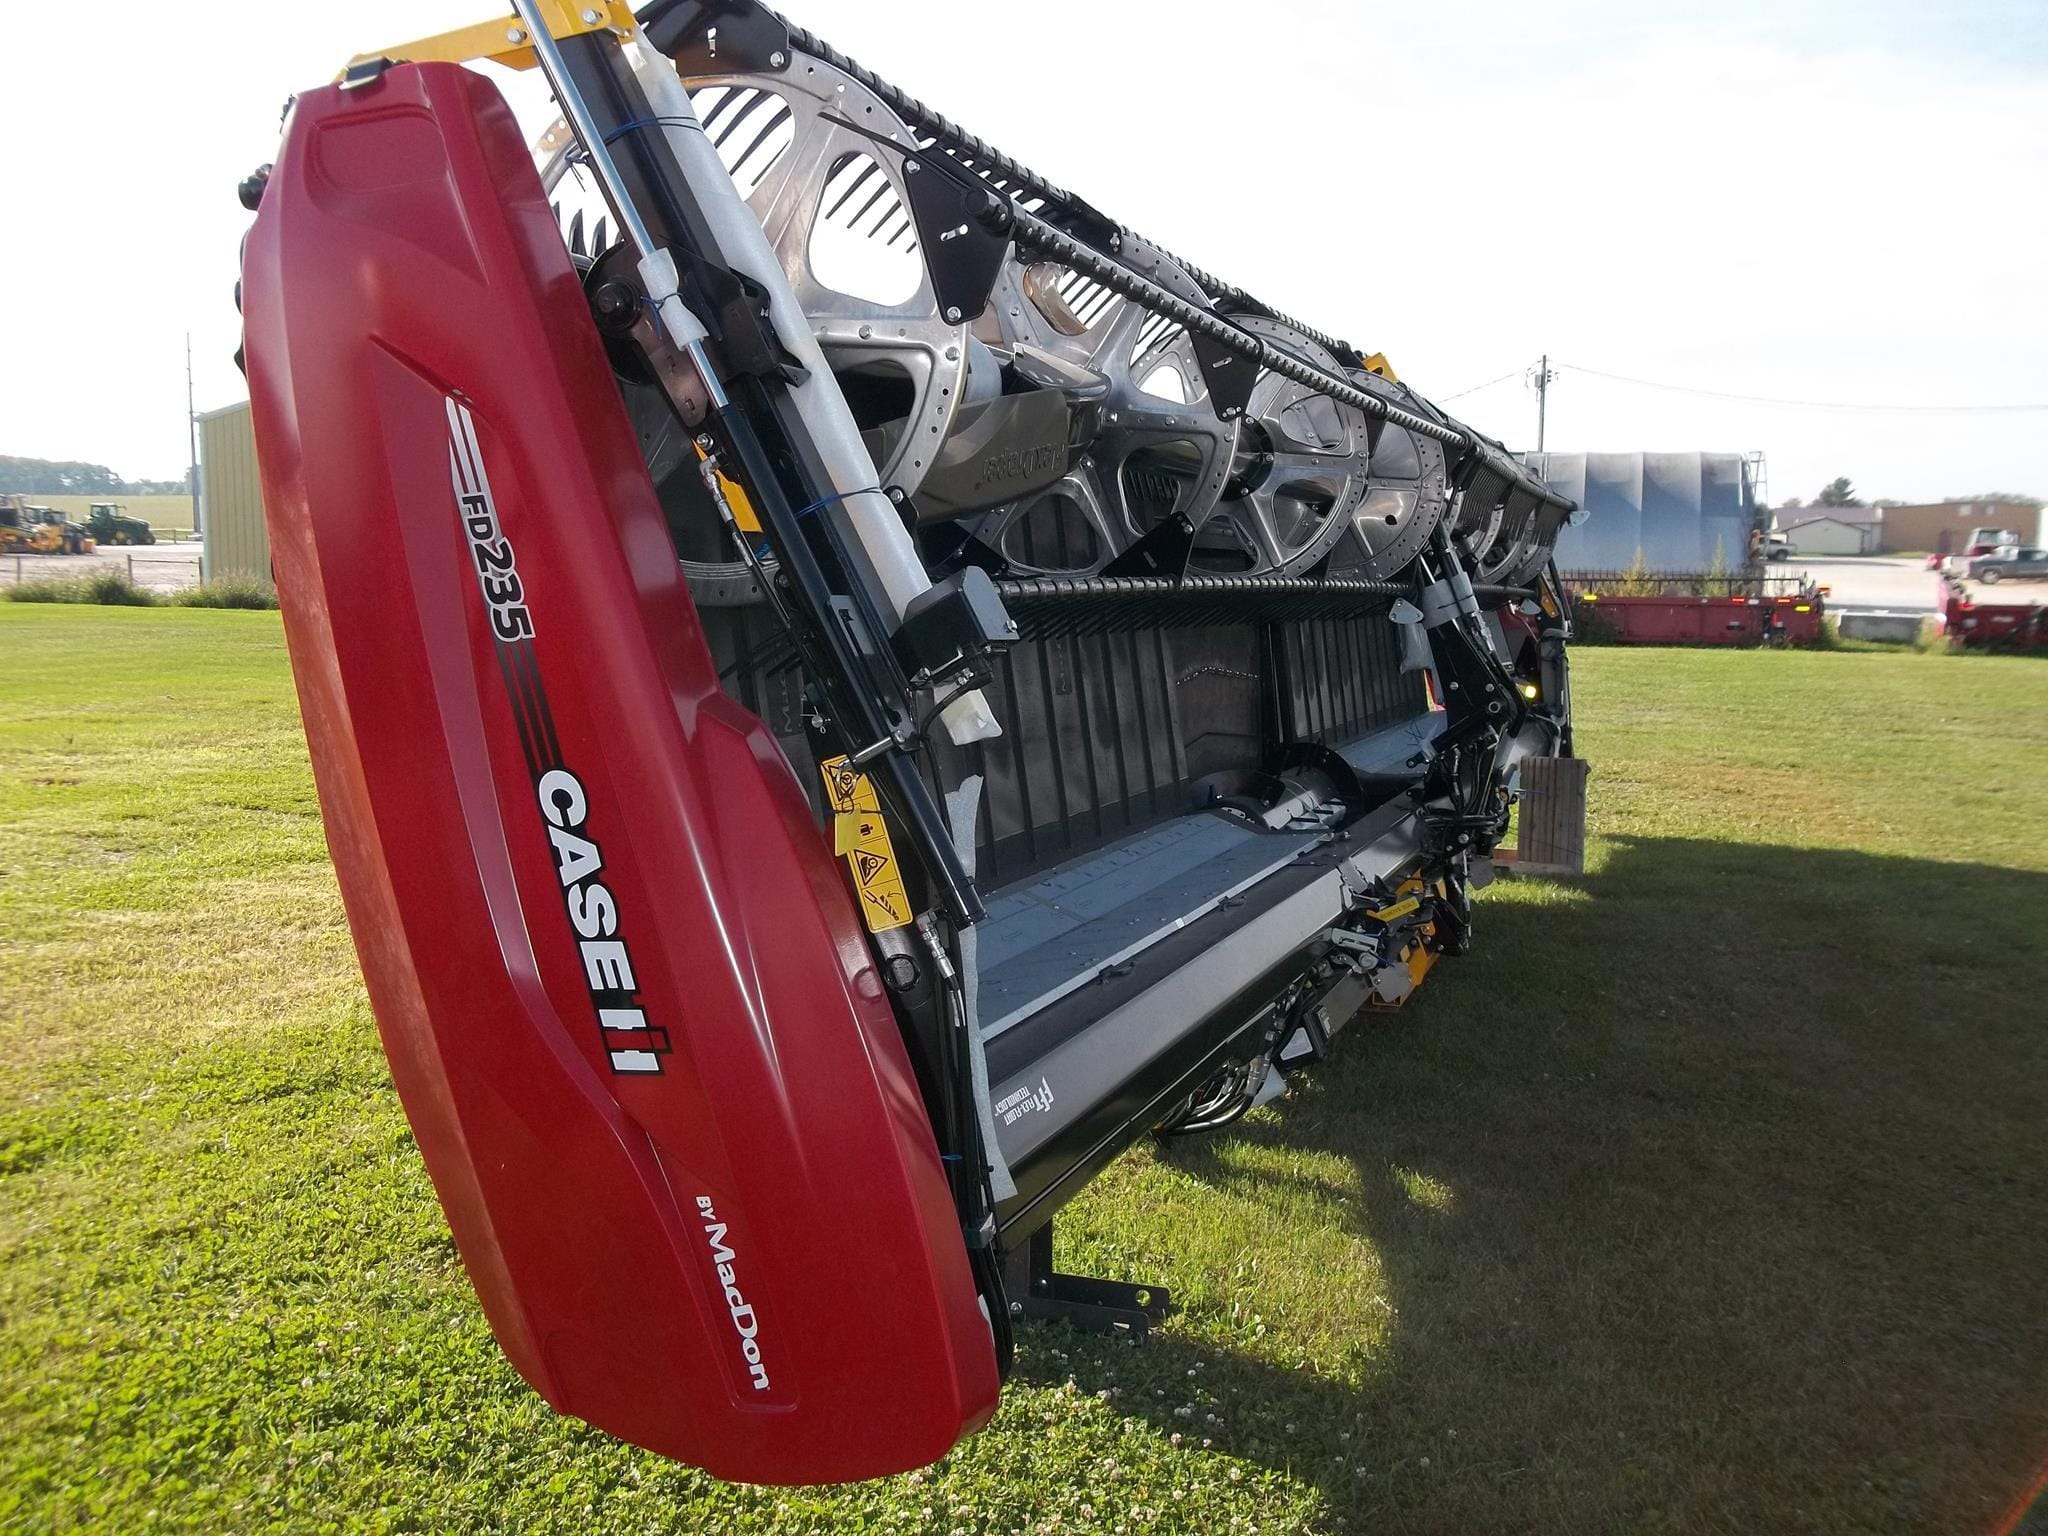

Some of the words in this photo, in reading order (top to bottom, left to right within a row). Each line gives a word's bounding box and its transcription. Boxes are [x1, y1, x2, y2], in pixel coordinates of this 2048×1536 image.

[461, 495, 536, 642] FD235
[538, 769, 636, 991] CASE
[996, 1086, 1031, 1114] TECHNOLOGY
[695, 1196, 717, 1220] BY
[705, 1222, 769, 1390] MacDon
